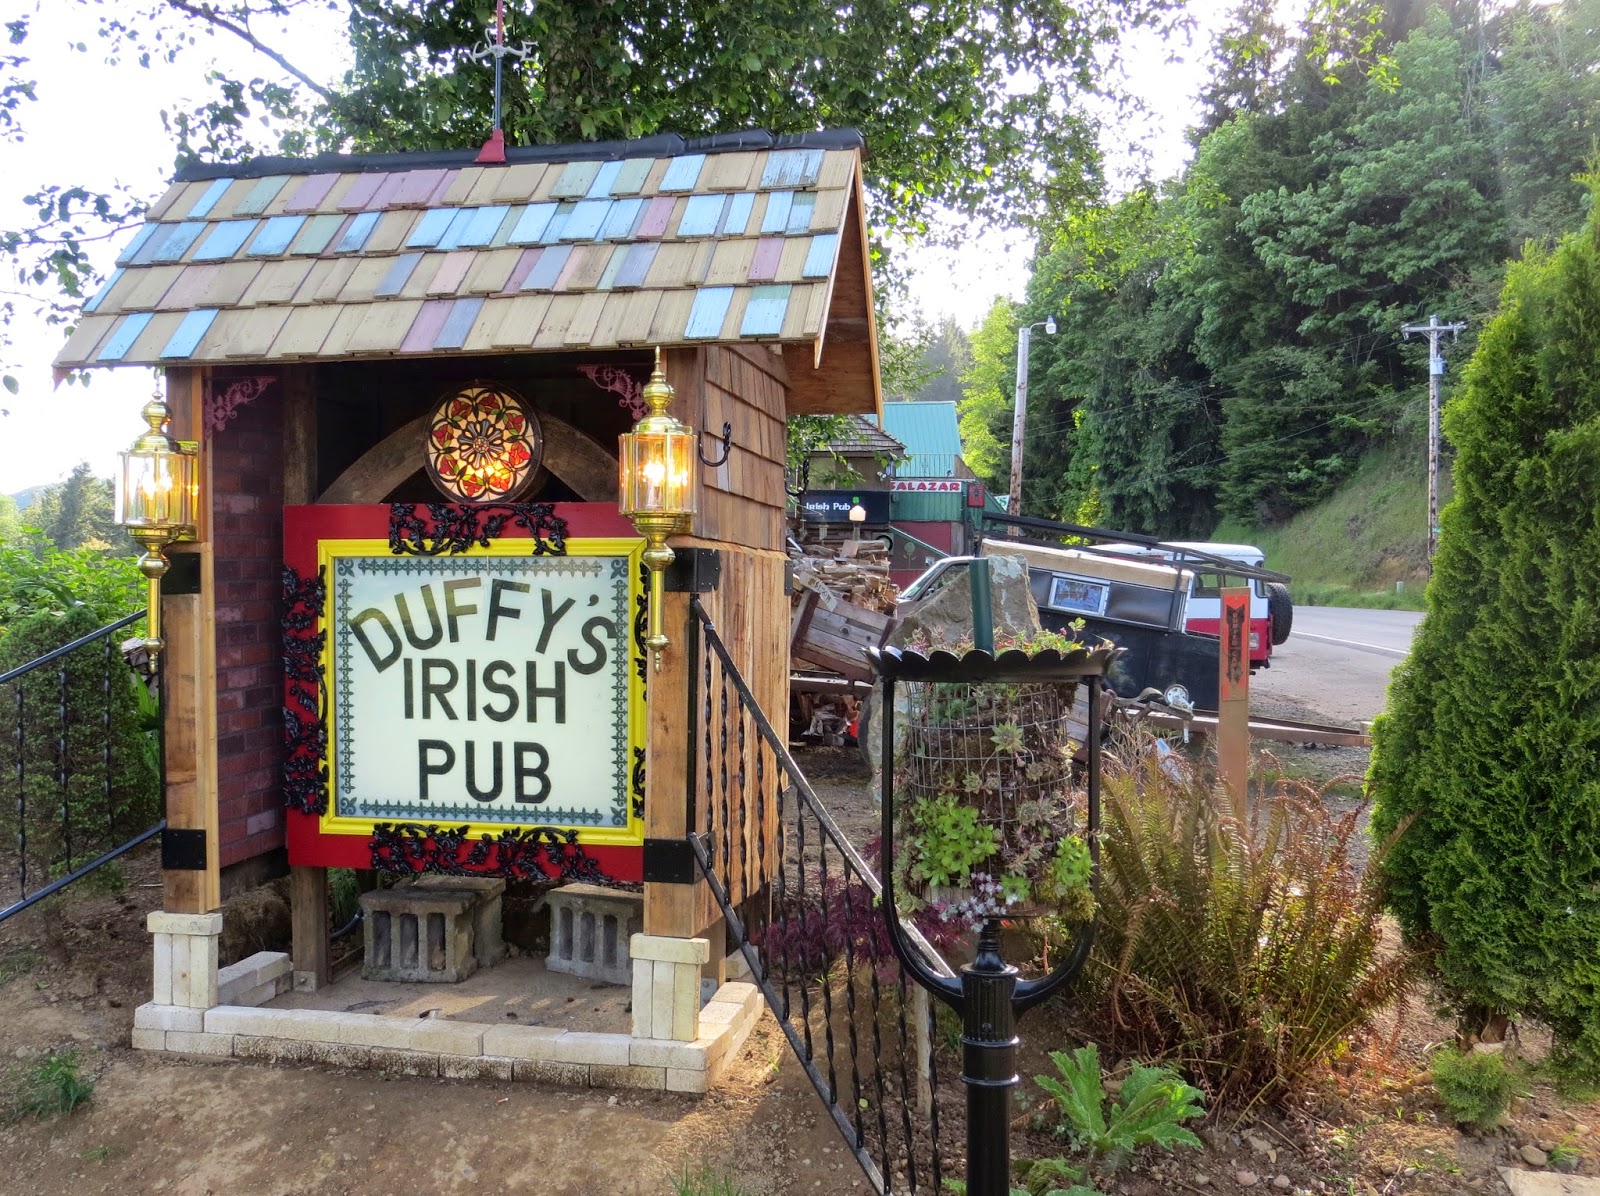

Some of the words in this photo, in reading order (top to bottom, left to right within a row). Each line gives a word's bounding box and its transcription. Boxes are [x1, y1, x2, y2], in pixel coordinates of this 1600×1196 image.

[805, 502, 830, 511] Irish
[833, 502, 851, 511] Pub
[890, 481, 960, 491] SALAZAR
[349, 577, 617, 675] DUFFY'S
[403, 658, 567, 724] IRISH
[418, 738, 552, 804] PUB
